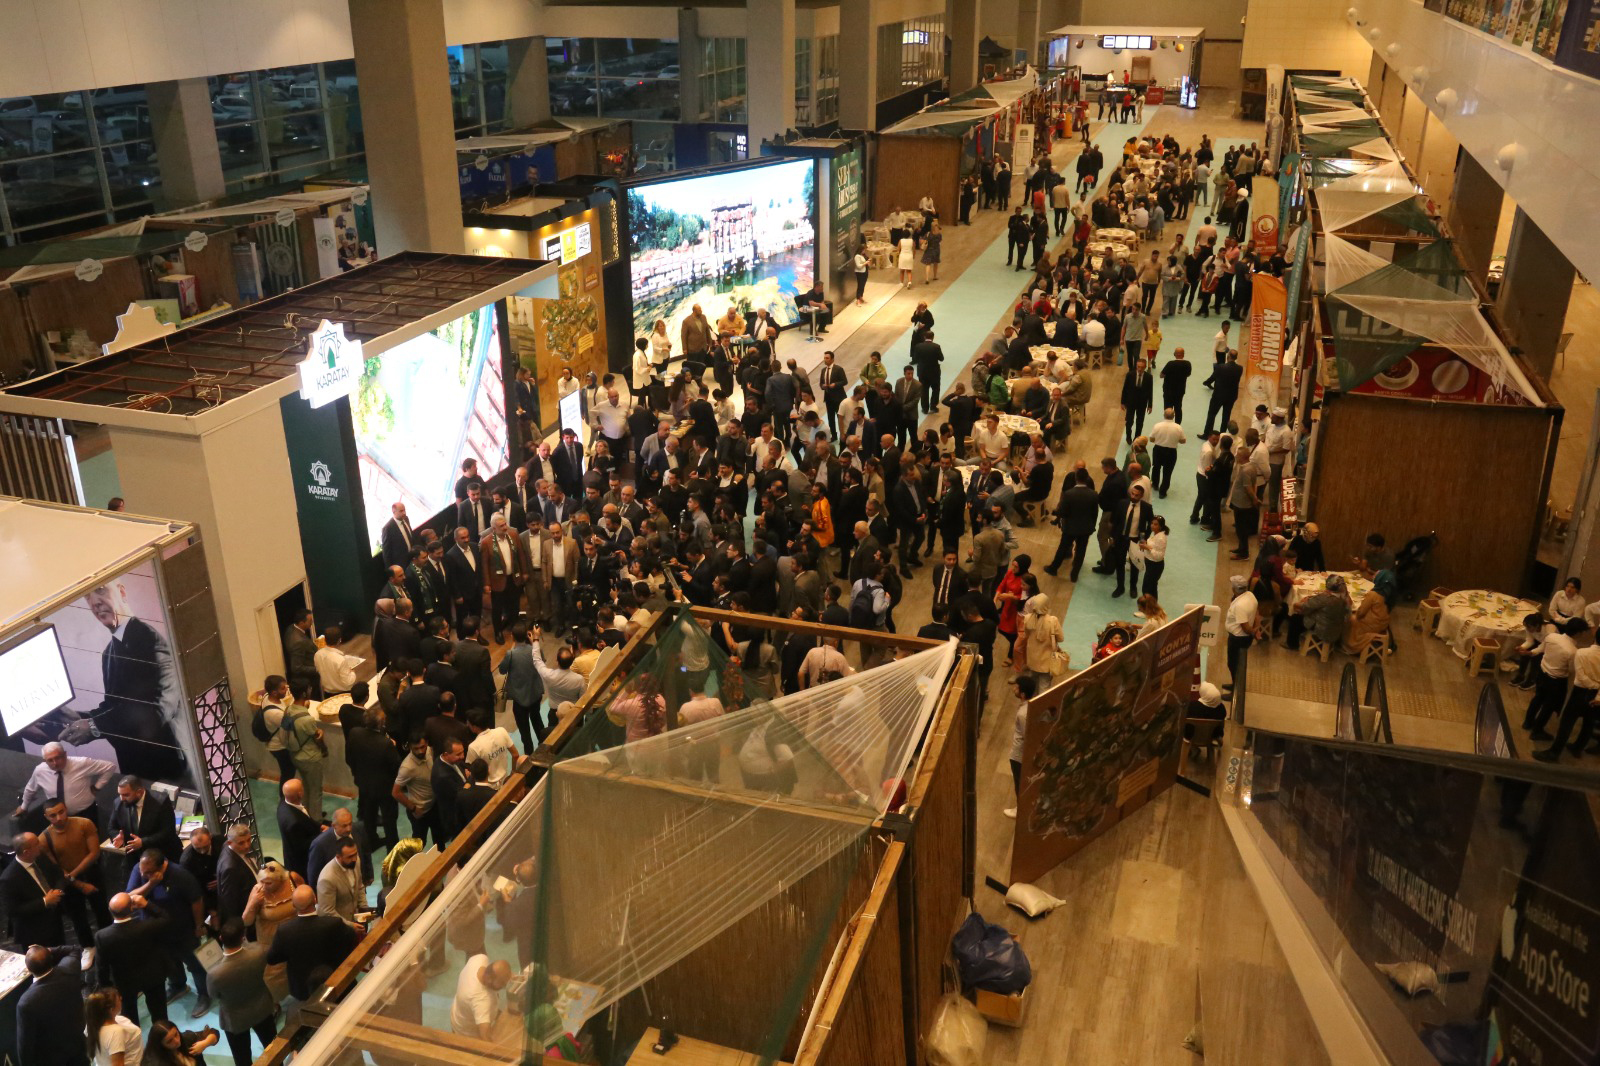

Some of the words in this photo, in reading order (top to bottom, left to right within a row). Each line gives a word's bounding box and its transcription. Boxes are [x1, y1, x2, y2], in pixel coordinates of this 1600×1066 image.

[316, 365, 350, 390] KARATAY
[307, 484, 338, 499] KARATAY
[1518, 932, 1547, 996] App
[1546, 949, 1590, 1018] Store
